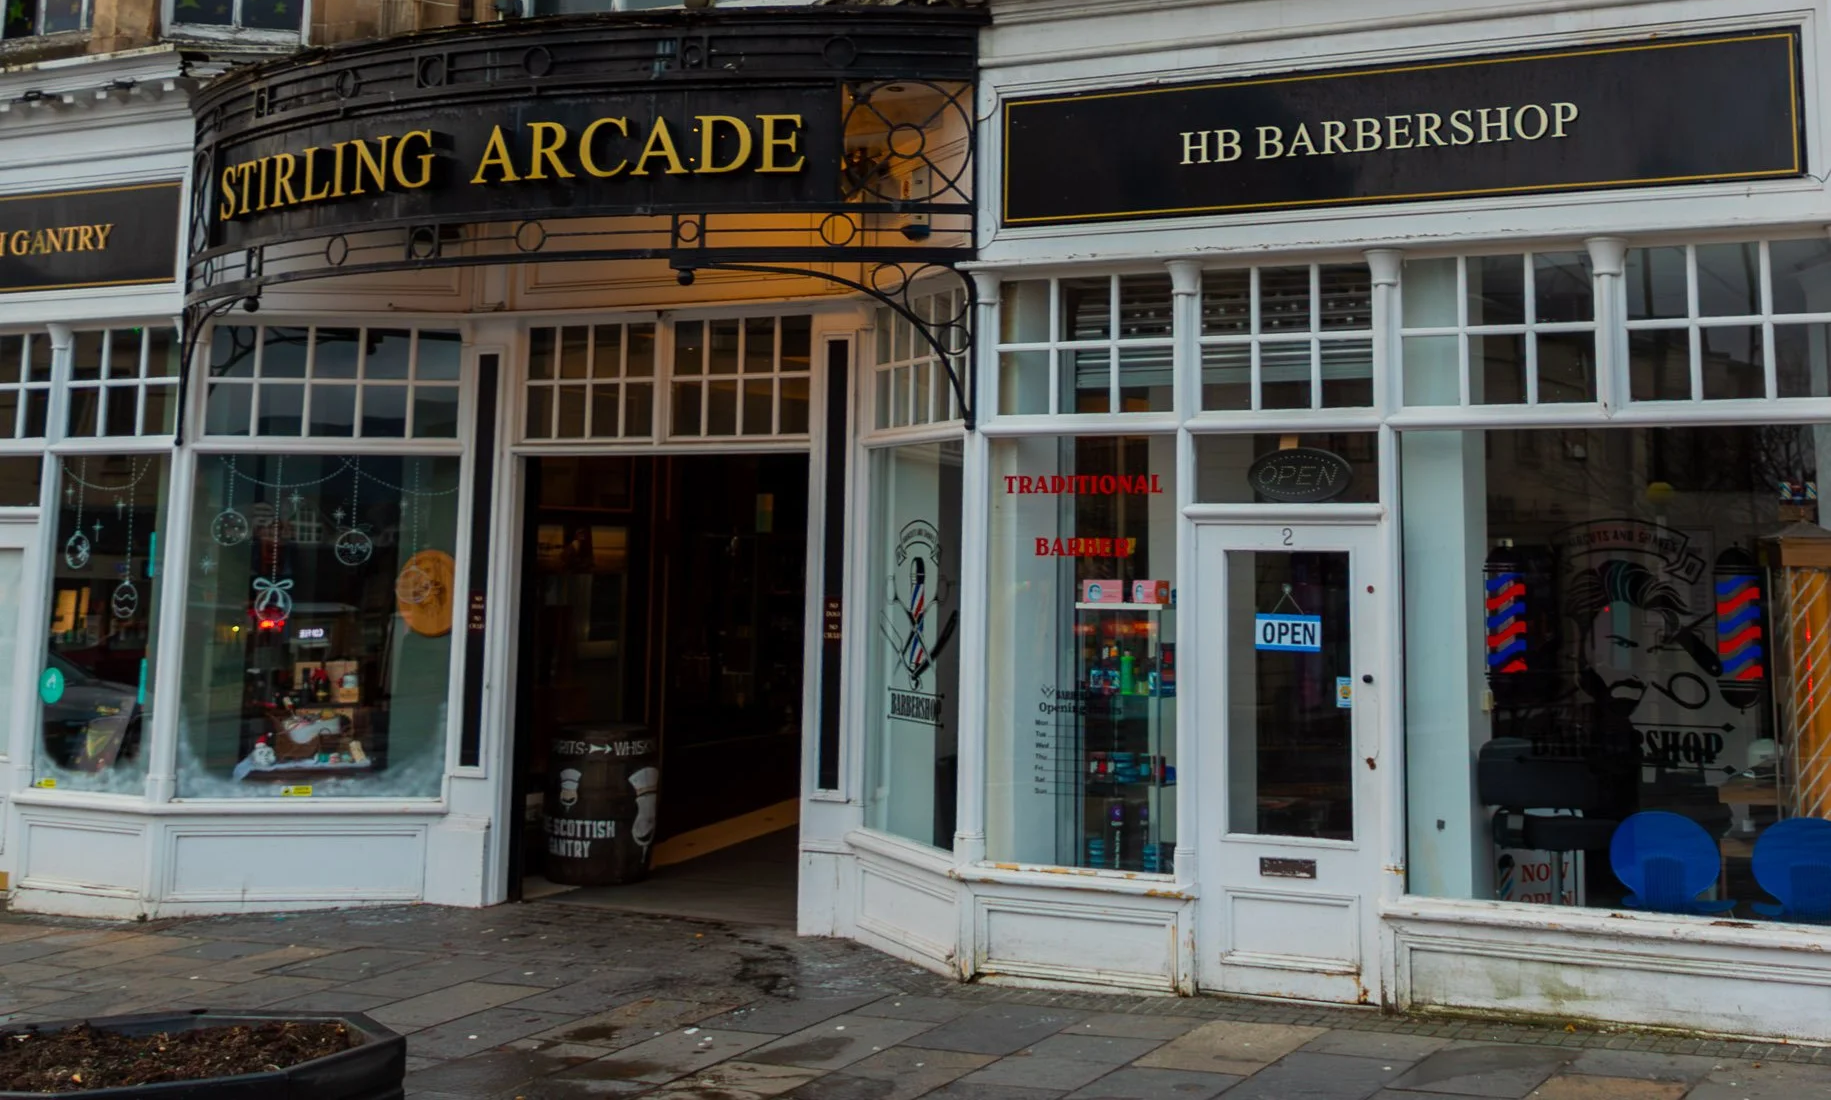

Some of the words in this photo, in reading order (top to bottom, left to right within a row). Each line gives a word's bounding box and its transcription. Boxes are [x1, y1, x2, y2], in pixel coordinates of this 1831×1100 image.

[1179, 129, 1242, 165] HB
[1255, 102, 1578, 160] BARBERSHOP
[219, 129, 435, 222] STIRLING
[470, 114, 805, 184] ARCADE
[10, 223, 114, 256] GANTRY
[1004, 474, 1163, 495] TRADITIONAL
[1258, 465, 1339, 487] OPEN
[1034, 537, 1130, 558] BARBER
[1281, 527, 1293, 546] 2
[1263, 622, 1315, 645] OPEN
[891, 692, 942, 722] BARBERSHOP
[1039, 701, 1088, 715] Opening
[554, 818, 616, 839] SCOTTISH
